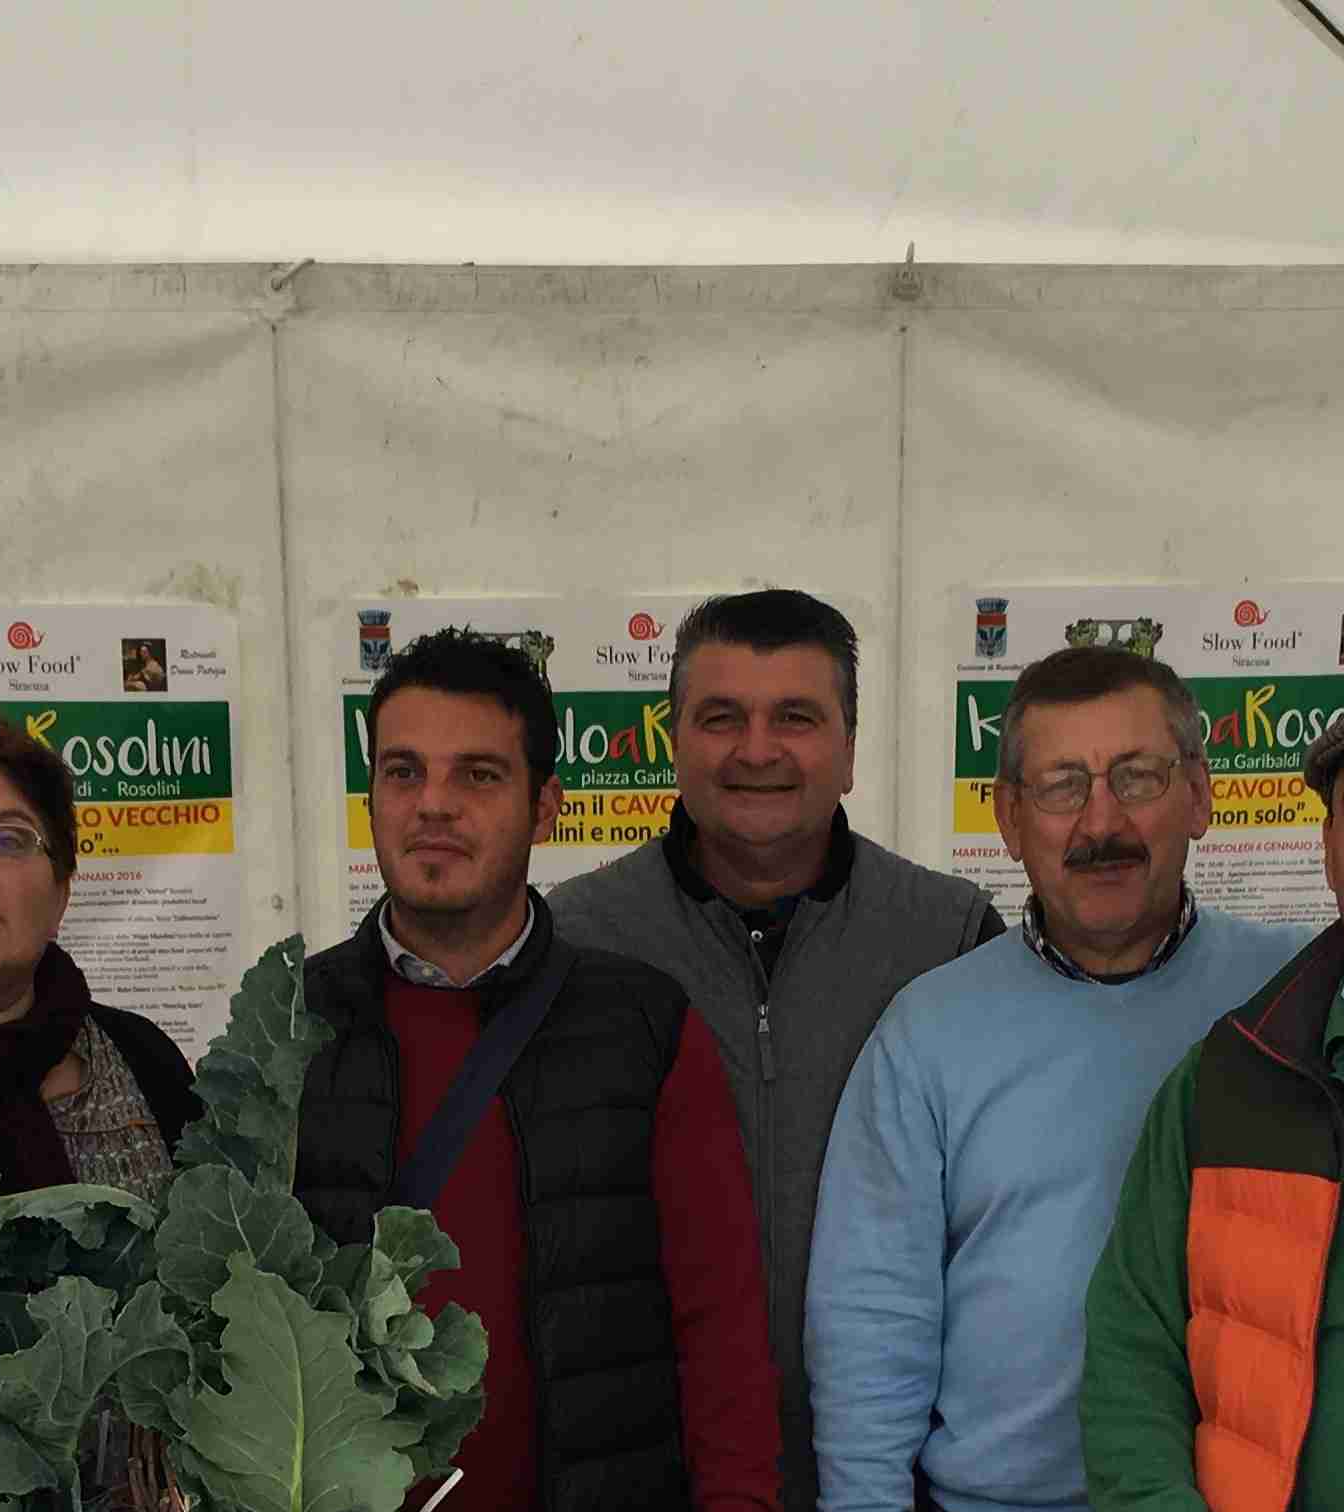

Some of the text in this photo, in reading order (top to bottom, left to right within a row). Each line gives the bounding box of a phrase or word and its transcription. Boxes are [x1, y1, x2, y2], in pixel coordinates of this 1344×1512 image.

[1202, 632, 1242, 651] Slow
[595, 646, 641, 665] Slow
[1234, 752, 1300, 770] Garibaldi
[581, 768, 678, 788] piazza Garib
[117, 779, 181, 798] Rosolini
[1211, 777, 1305, 800] CAVOLO
[107, 802, 222, 828] VECCHIO
[591, 796, 605, 816] il
[1209, 809, 1248, 826] non
[591, 825, 604, 842] e
[609, 824, 651, 842] non
[117, 870, 144, 882] 2016
[347, 863, 379, 874] MART
